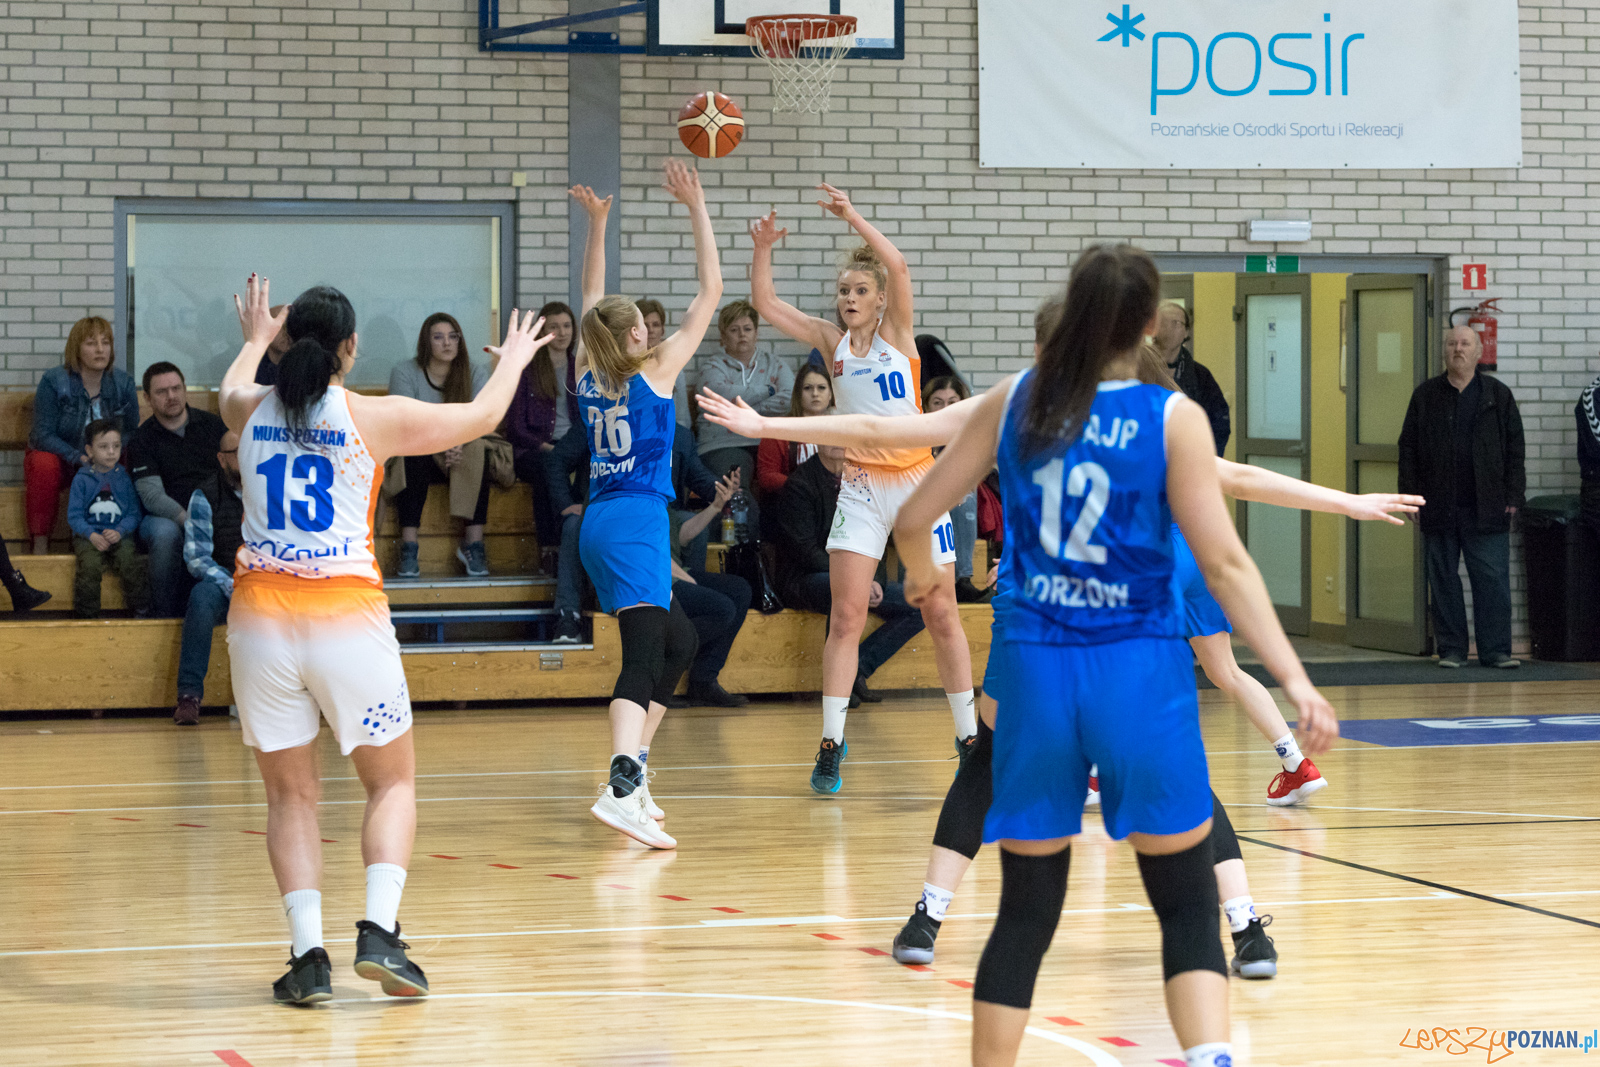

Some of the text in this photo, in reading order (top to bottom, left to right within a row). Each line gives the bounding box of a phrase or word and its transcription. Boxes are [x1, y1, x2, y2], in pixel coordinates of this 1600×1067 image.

[1151, 122, 1229, 137] Poznańskie
[1233, 122, 1286, 137] Ośrodki
[1290, 122, 1335, 138] Sportu
[1345, 122, 1404, 139] Rekreacji
[873, 371, 906, 401] 10
[253, 425, 290, 442] MUKS
[587, 405, 632, 458] 26
[1082, 414, 1139, 449] AJP
[256, 453, 334, 532] 13
[1032, 457, 1110, 565] 12
[933, 522, 955, 553] 10
